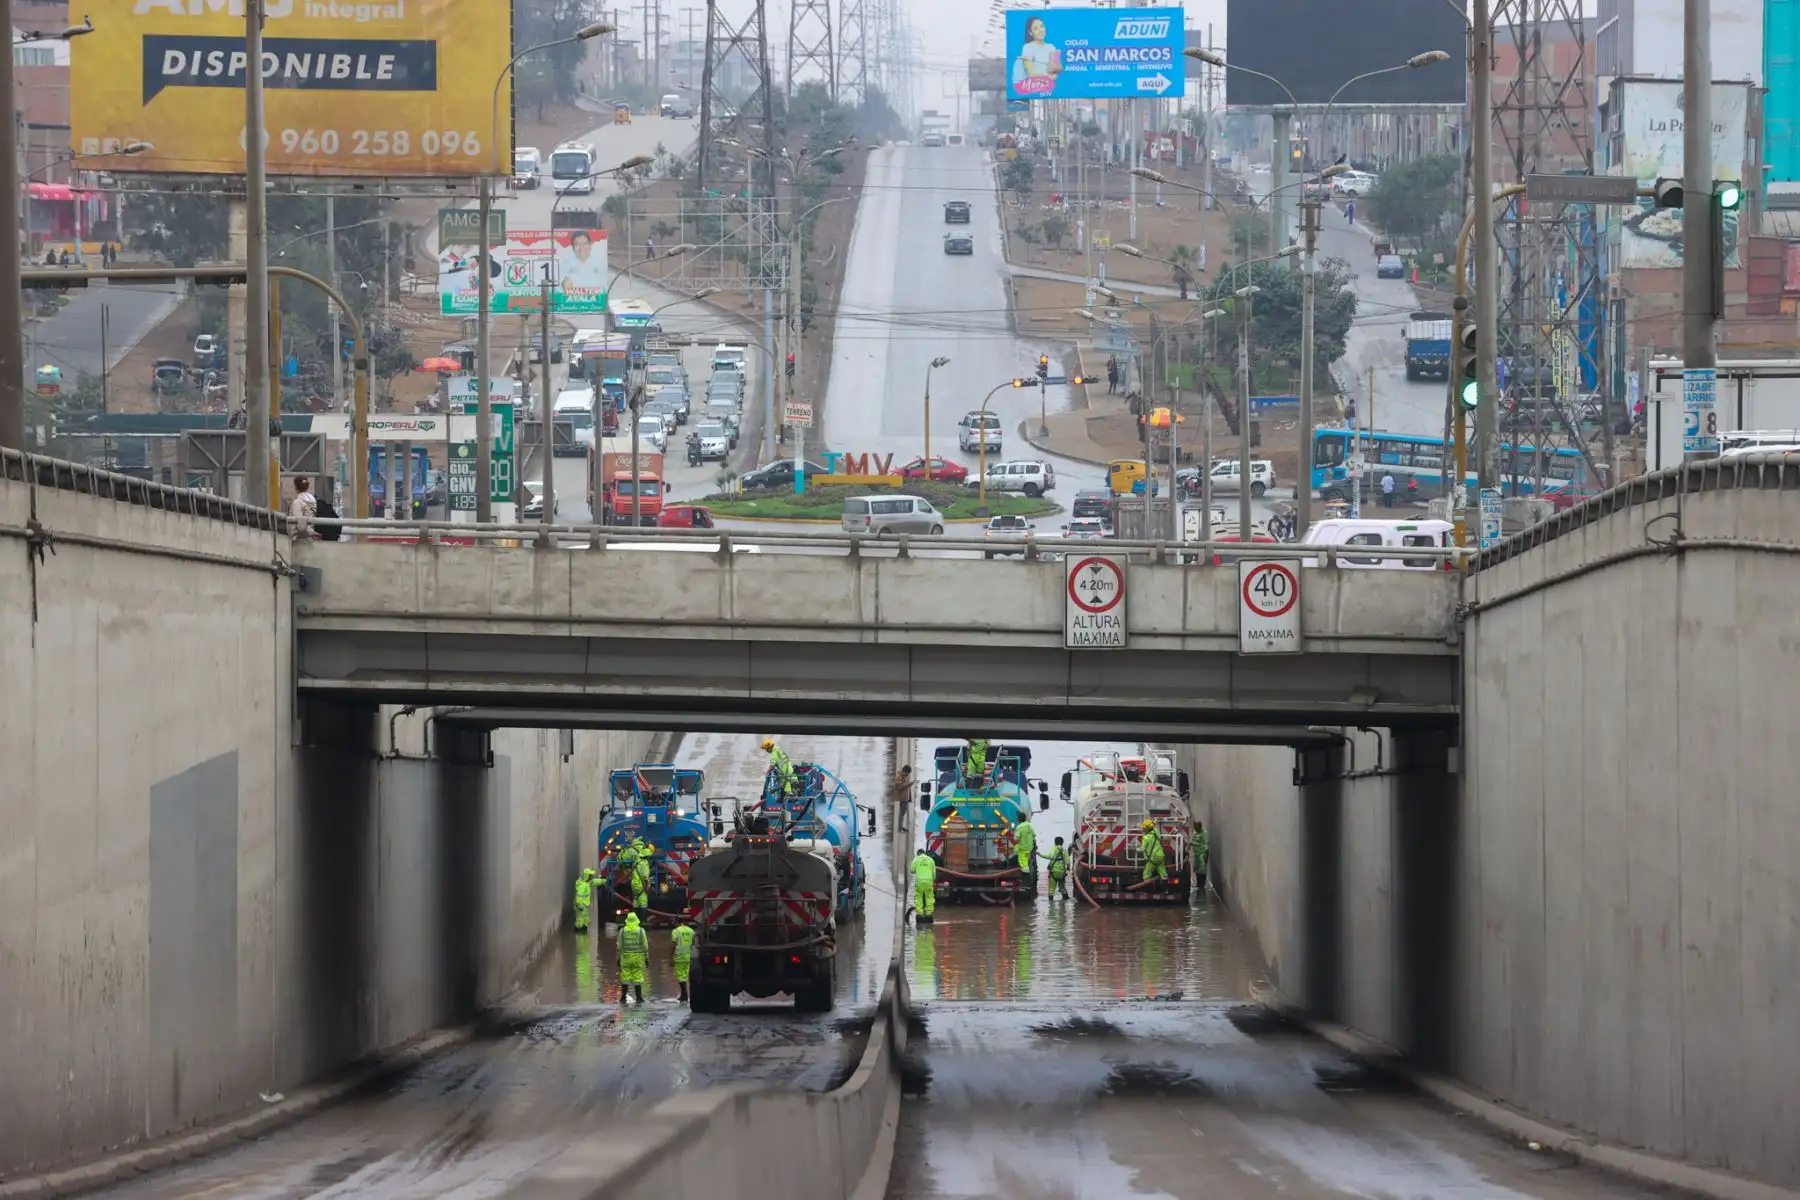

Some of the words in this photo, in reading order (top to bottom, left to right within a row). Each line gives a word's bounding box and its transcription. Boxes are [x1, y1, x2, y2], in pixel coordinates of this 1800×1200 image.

[1117, 23, 1166, 36] ADUNI
[1066, 49, 1099, 62] SAN
[1104, 48, 1172, 61] MARCOS
[162, 50, 396, 80] DISPONIBLE
[281, 128, 340, 154] 960
[352, 129, 410, 155] 258
[422, 130, 481, 156] 096
[443, 212, 480, 227] AMG
[786, 408, 813, 417] TERRENO
[450, 476, 476, 493] GNV
[1079, 579, 1114, 591] 4.20m
[1254, 573, 1286, 597] 40
[1073, 615, 1121, 628] ALTURA
[1073, 632, 1121, 645] MAXIMA
[1248, 629, 1295, 639] MAXIMA
